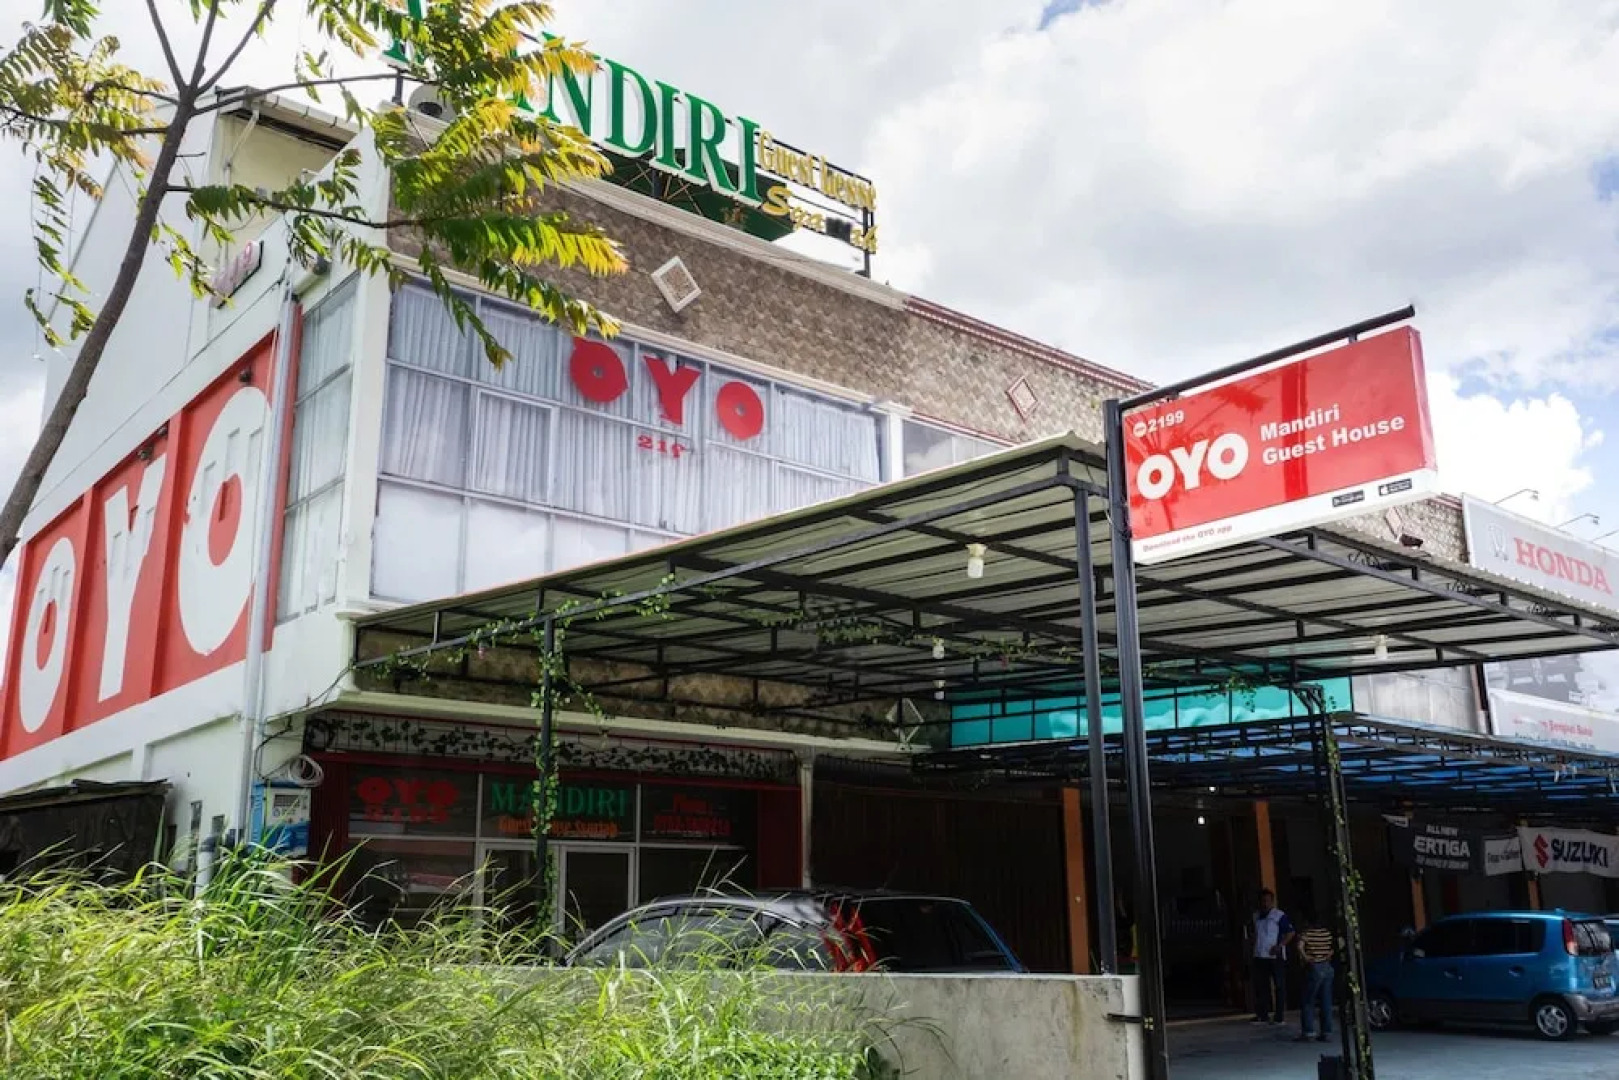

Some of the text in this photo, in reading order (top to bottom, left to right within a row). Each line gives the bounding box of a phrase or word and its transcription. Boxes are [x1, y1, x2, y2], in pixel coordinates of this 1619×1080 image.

[383, 0, 762, 203] NDIRI
[757, 131, 816, 188] Guest
[569, 336, 765, 441] OYO
[1148, 409, 1185, 433] 2199
[1260, 403, 1340, 441] Mandiri
[1262, 414, 1405, 466] Guest House
[1136, 433, 1249, 500] OYO
[18, 385, 273, 734] OYO
[1514, 537, 1613, 595] HONDA
[356, 776, 460, 806] OYO
[490, 781, 630, 817] MADIRI
[1413, 835, 1471, 858] ERTIGA
[1550, 838, 1609, 868] SUZUKI
